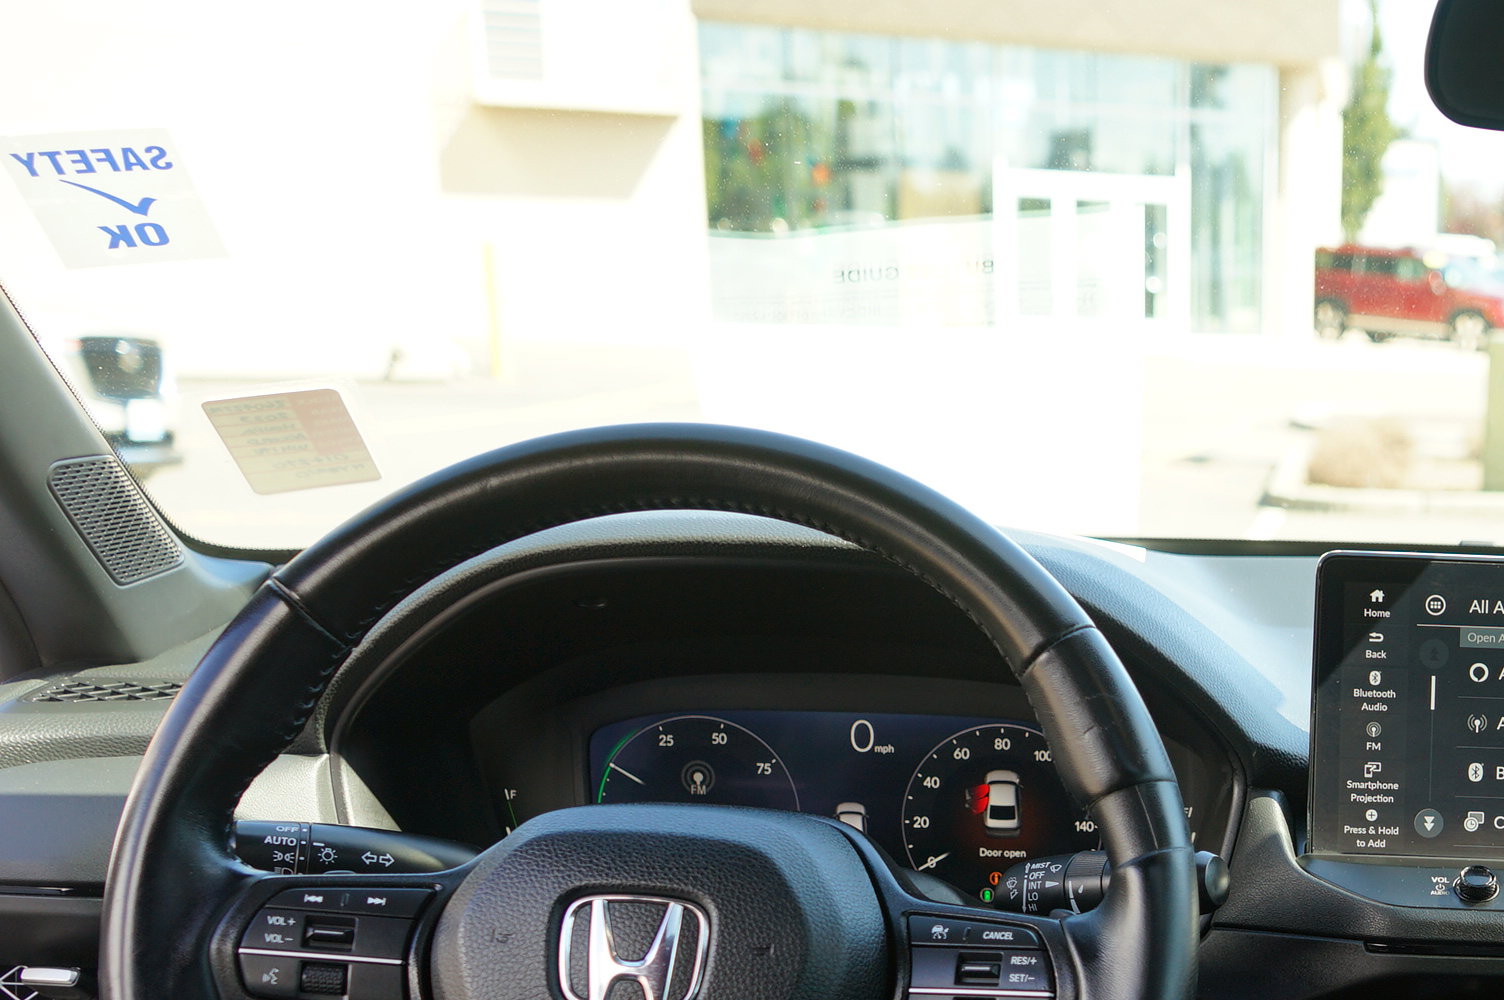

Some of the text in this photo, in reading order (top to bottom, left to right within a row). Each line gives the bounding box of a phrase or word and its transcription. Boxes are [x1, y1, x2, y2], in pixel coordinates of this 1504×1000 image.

[1469, 599, 1489, 614] All
[1363, 608, 1390, 618] Home
[1467, 633, 1496, 646] Open
[1365, 650, 1387, 659] Back
[1353, 689, 1396, 699] Bluetooth
[1361, 702, 1388, 712] Audio
[658, 734, 674, 747] 25
[711, 732, 727, 745] 50
[850, 719, 894, 755] 0 mph
[994, 738, 1011, 750] 80
[1366, 742, 1381, 751] FM
[953, 748, 970, 760] 60
[756, 762, 772, 775] 75
[923, 776, 940, 788] 40
[1346, 780, 1399, 792] Smartphone
[510, 789, 517, 800] F
[690, 784, 706, 796] FM
[1350, 793, 1394, 805] Projection
[913, 816, 929, 828] 20
[1075, 821, 1094, 832] 140
[1344, 826, 1399, 836] Press & Hold
[264, 836, 297, 847] AUTO
[1356, 839, 1386, 848] to Add
[979, 848, 1027, 859] Door open
[1031, 862, 1051, 870] MIST
[1029, 871, 1046, 880] OFF
[1431, 876, 1450, 884] VOL
[1028, 881, 1042, 890] INT
[1028, 892, 1039, 901] LO
[1028, 903, 1038, 912] HI
[983, 931, 1014, 941] CANCEL
[1010, 956, 1037, 966] RES/+
